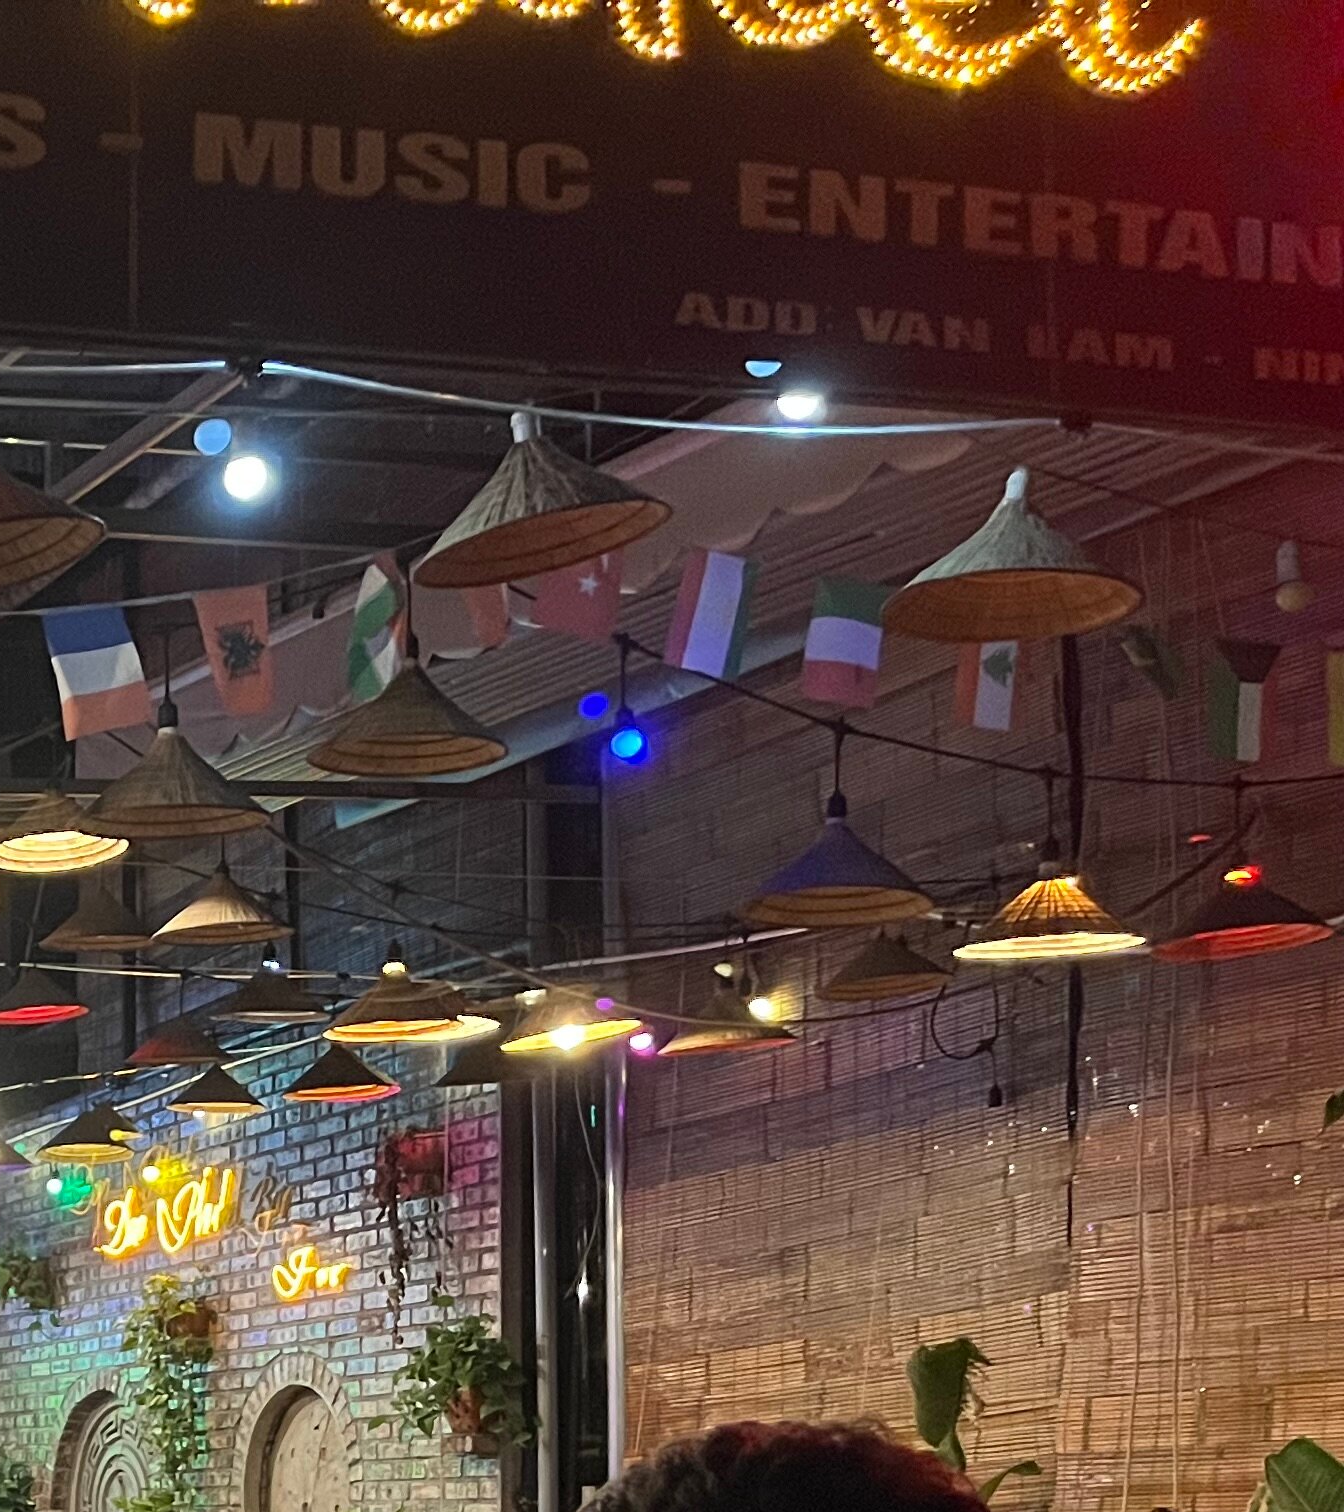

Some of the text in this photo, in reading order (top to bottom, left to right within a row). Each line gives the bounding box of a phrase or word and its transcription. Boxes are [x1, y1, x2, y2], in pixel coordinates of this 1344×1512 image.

[192, 111, 593, 212] MUSIC
[736, 158, 1344, 287] ENTERTAIN
[856, 306, 991, 352] VAN
